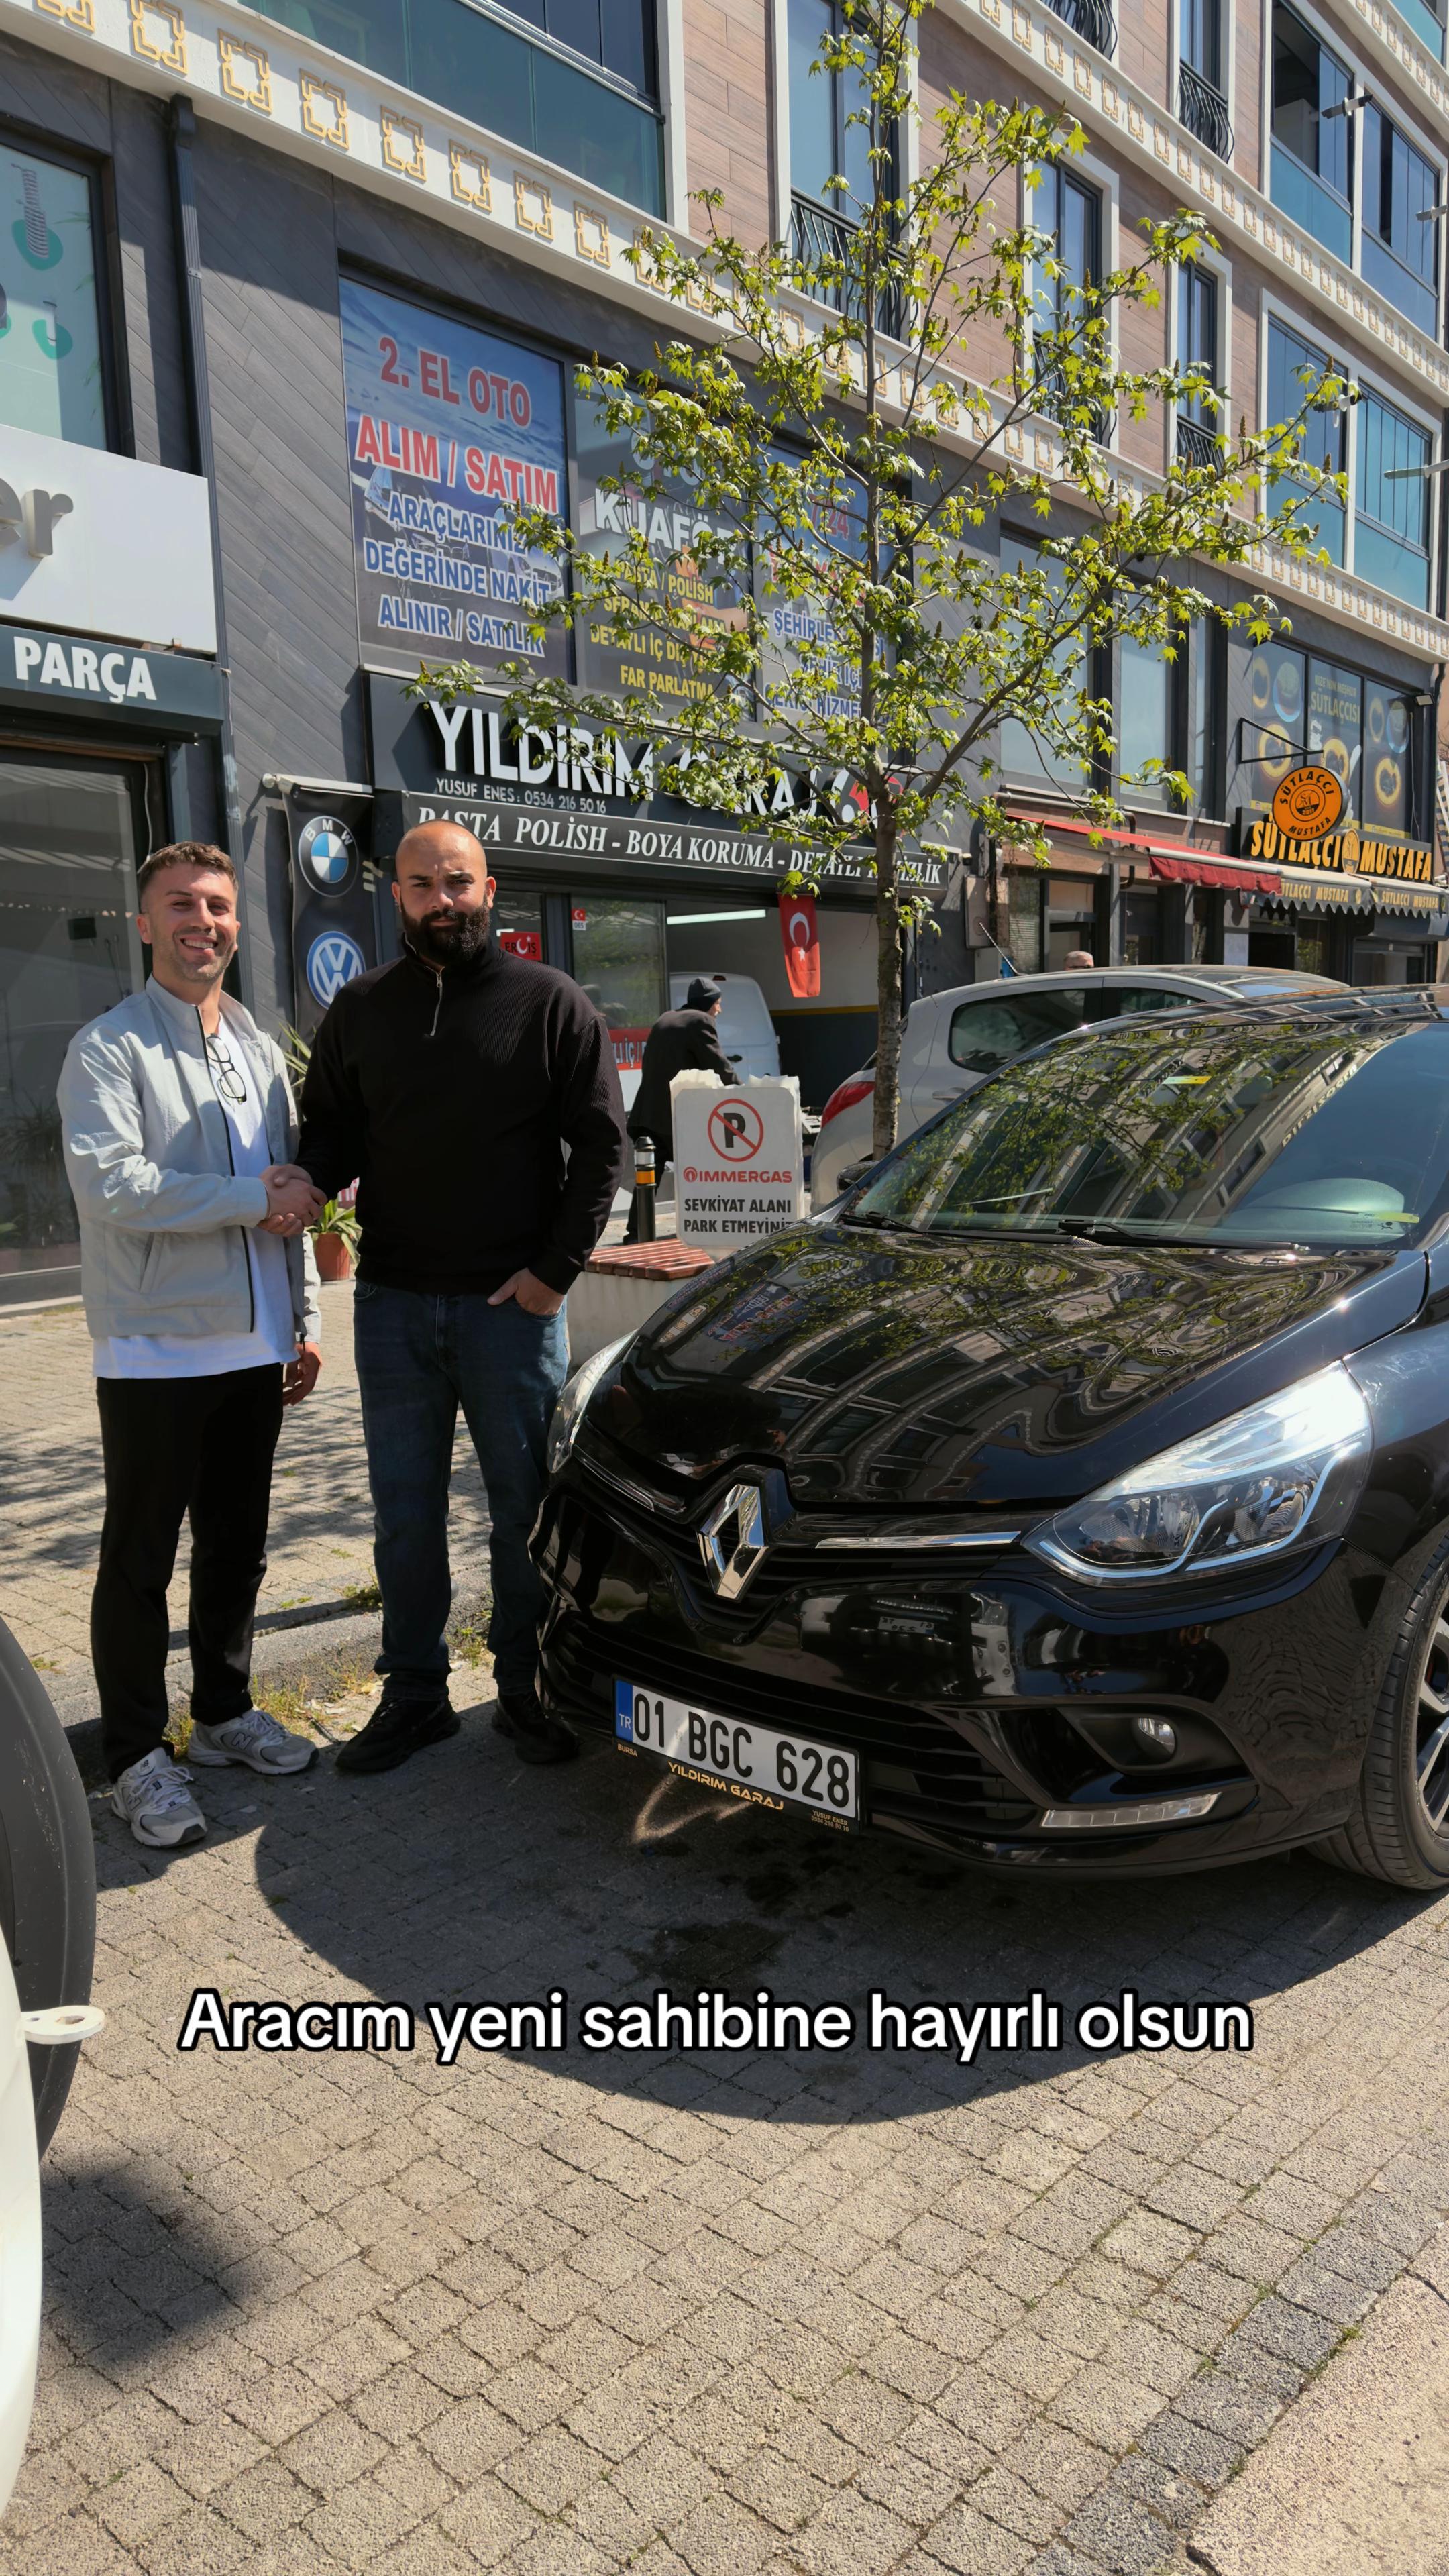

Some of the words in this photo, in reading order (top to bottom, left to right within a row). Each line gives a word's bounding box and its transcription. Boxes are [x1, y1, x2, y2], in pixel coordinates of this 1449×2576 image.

[378, 335, 409, 389] 2.
[417, 348, 461, 406] EL
[468, 367, 532, 427] OTO
[355, 413, 441, 483] ALIM
[464, 446, 559, 515] SATIM
[363, 537, 488, 598] DEĞERİNDE
[668, 574, 714, 604] POLİSH
[377, 594, 454, 640] ALINIR
[13, 637, 157, 704] PARÇA
[620, 665, 646, 690] FAR
[649, 672, 714, 700] PARLATMA
[436, 777, 478, 798] YUSUF
[525, 789, 555, 808] 0534
[559, 796, 576, 810] 216
[580, 798, 594, 812] 50
[596, 800, 606, 814] 16
[305, 818, 354, 846] BMW
[514, 816, 608, 852] POLİSH
[625, 830, 682, 859] BOYA
[687, 837, 774, 870] KORUMA
[1288, 817, 1331, 836] MUSTAFA
[1359, 840, 1432, 881] MUSTAFA
[1316, 886, 1350, 903] MUSTAFA
[700, 1171, 792, 1183] IMMERGAS
[684, 1195, 745, 1212] SEVKİYAT
[749, 1199, 792, 1213] ALANI
[684, 1220, 718, 1233] PARK
[619, 1713, 632, 1731] TR
[634, 1693, 665, 1748] 01
[688, 1711, 753, 1778] BGC
[776, 1741, 849, 1808] 628
[617, 1743, 638, 1758] BURSA
[667, 1760, 727, 1792] YILDIRIM
[730, 1784, 784, 1811] GARAJ
[812, 1809, 831, 1821] YUSUF
[832, 1816, 848, 1827] ENES
